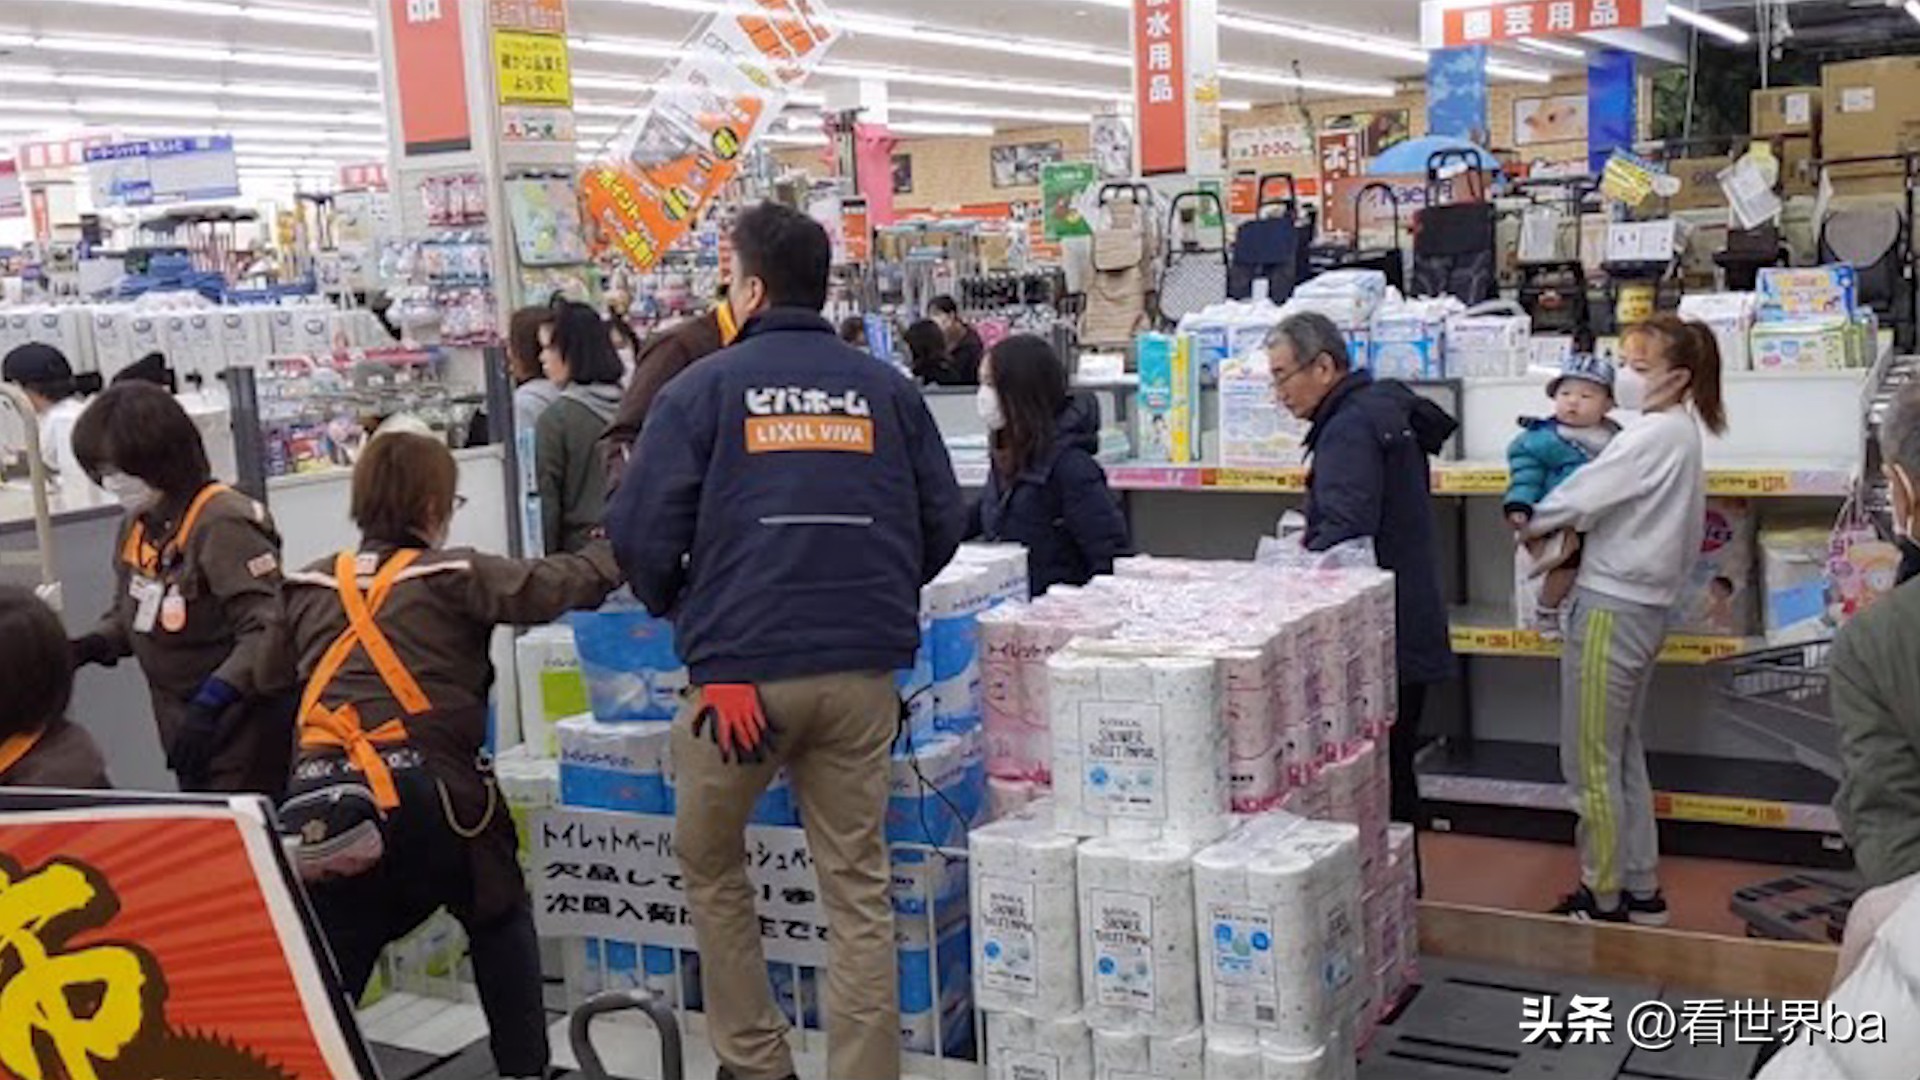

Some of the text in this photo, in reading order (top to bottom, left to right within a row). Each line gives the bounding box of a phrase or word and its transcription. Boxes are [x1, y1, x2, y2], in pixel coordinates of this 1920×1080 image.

[1146, 0, 1173, 104] 水用品
[746, 386, 871, 416] ビバホーム
[756, 422, 864, 444] LIXIL VIVA
